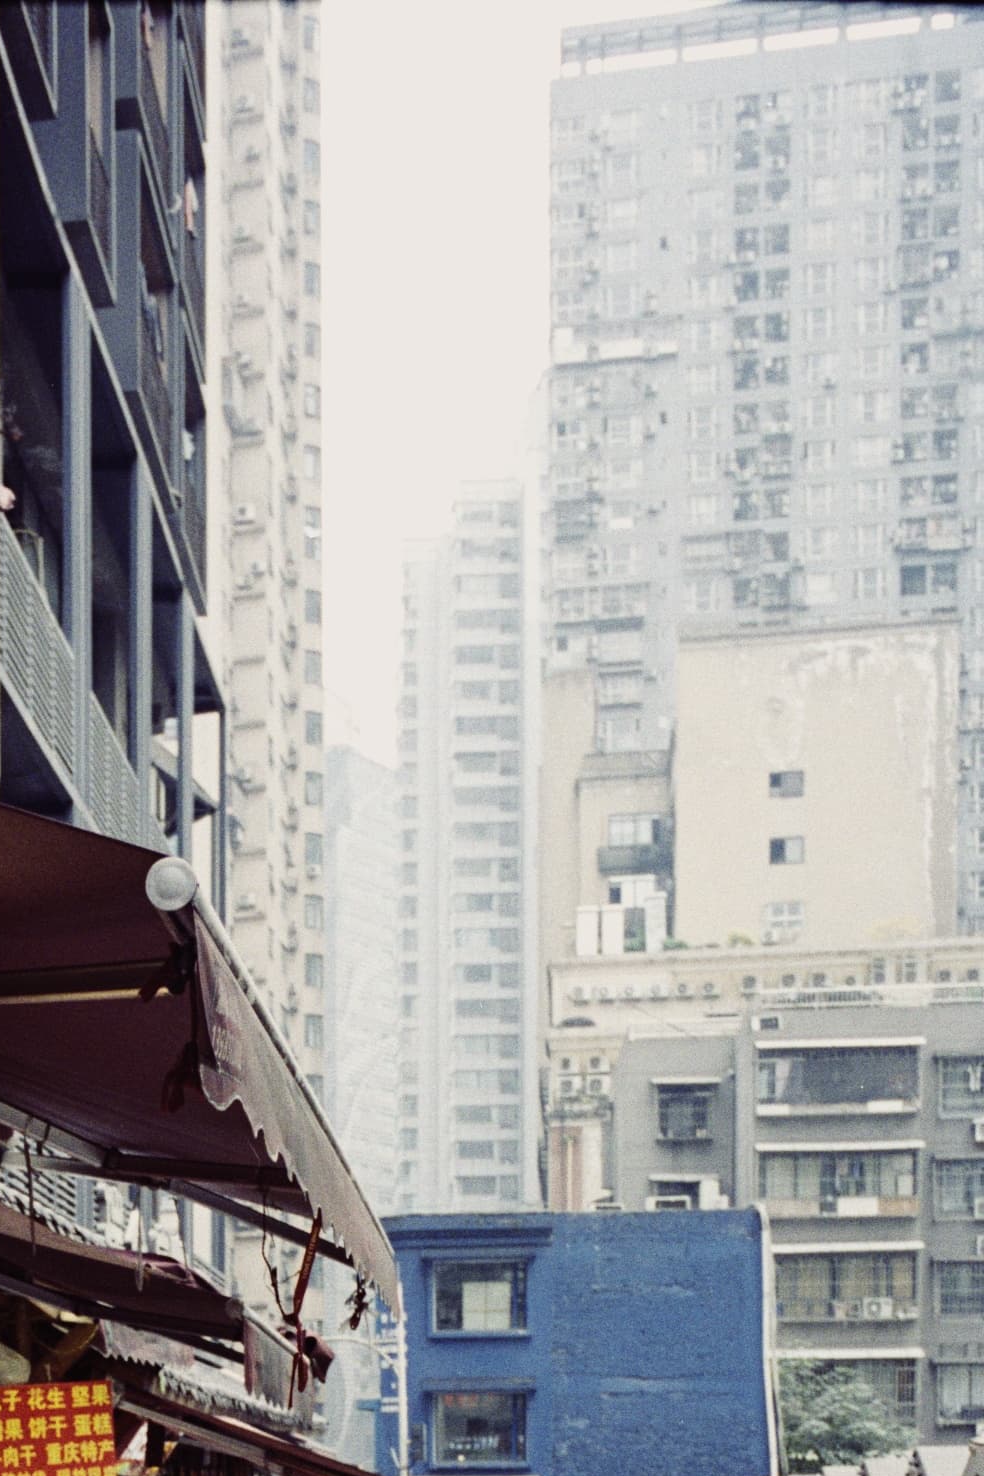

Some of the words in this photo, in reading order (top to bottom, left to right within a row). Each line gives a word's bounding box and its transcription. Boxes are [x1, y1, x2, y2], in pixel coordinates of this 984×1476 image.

[28, 1386, 66, 1411] 花生
[71, 1384, 110, 1408] 坚果
[28, 1415, 68, 1440] 饼干
[73, 1412, 113, 1437] 蛋糕
[46, 1439, 114, 1465] 重庆特产
